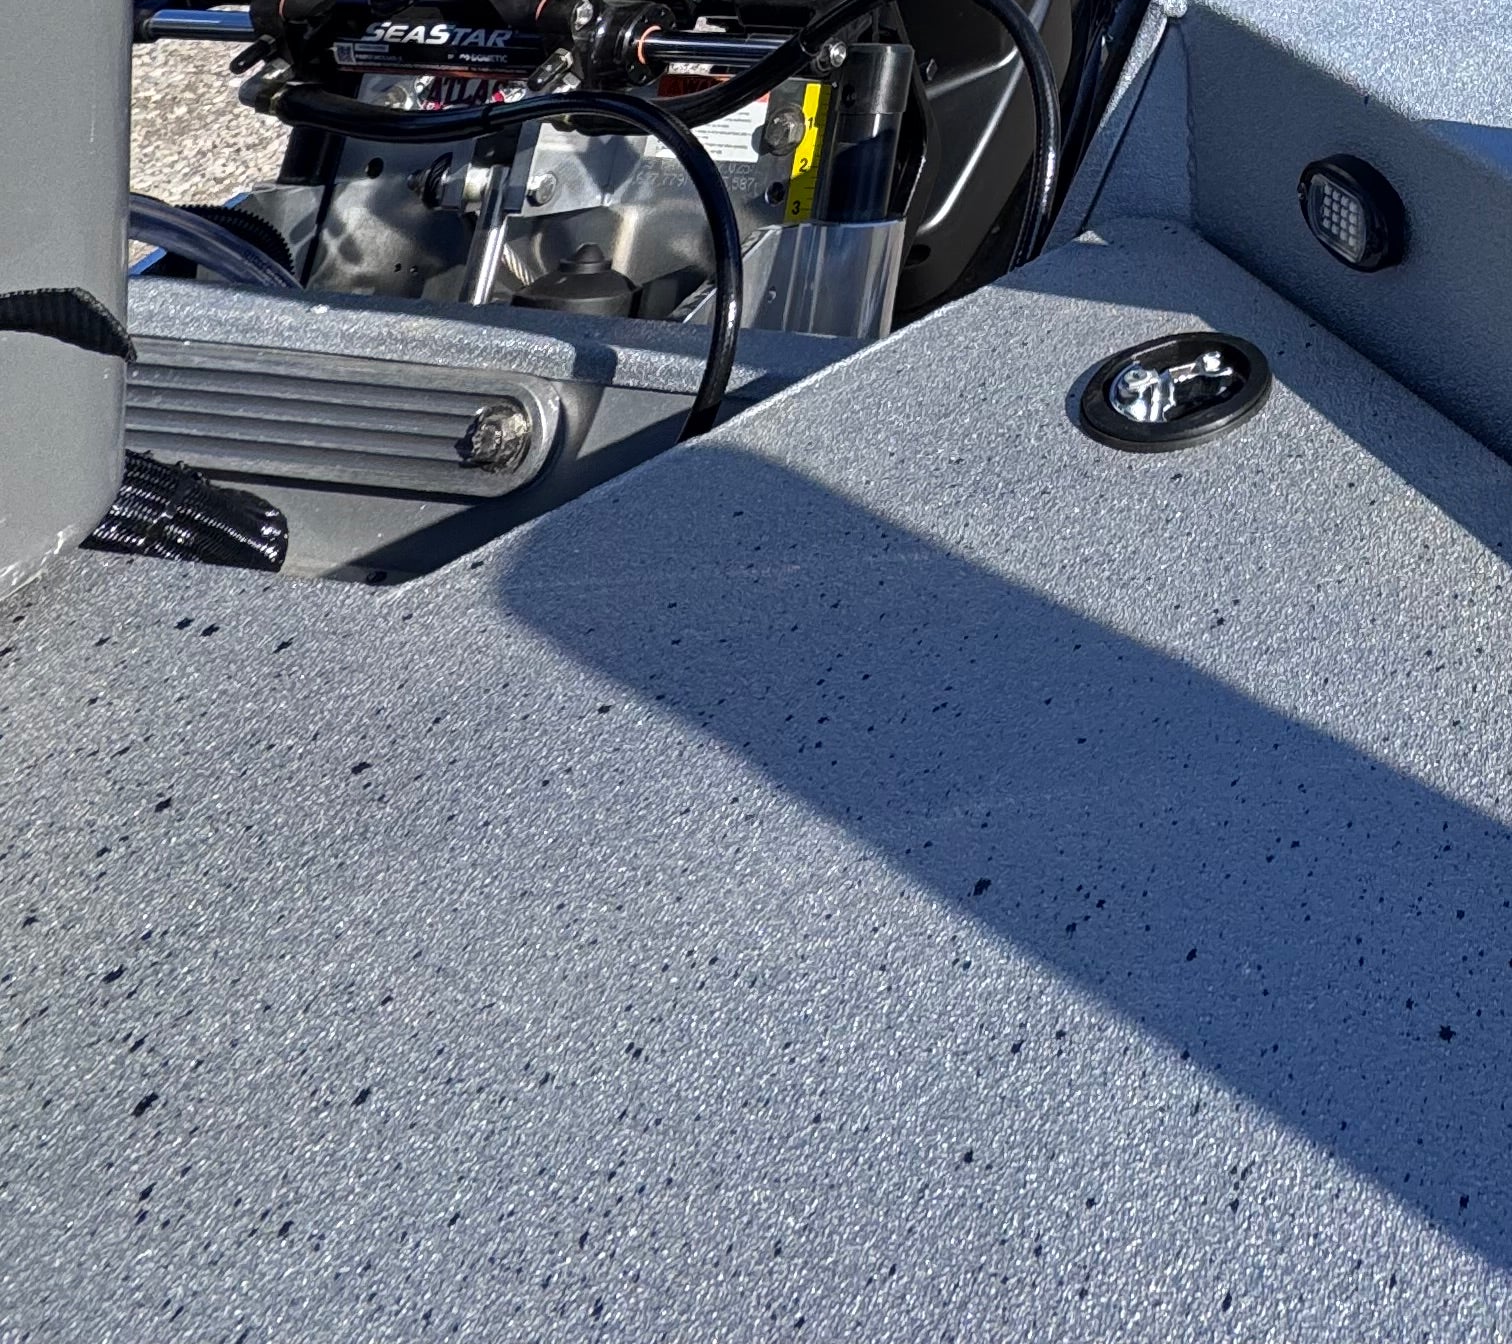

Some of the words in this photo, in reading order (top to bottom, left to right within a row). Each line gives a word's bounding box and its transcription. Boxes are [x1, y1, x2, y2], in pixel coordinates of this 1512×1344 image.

[807, 116, 814, 130] 1
[799, 157, 809, 172] 2
[791, 200, 801, 215] 3
